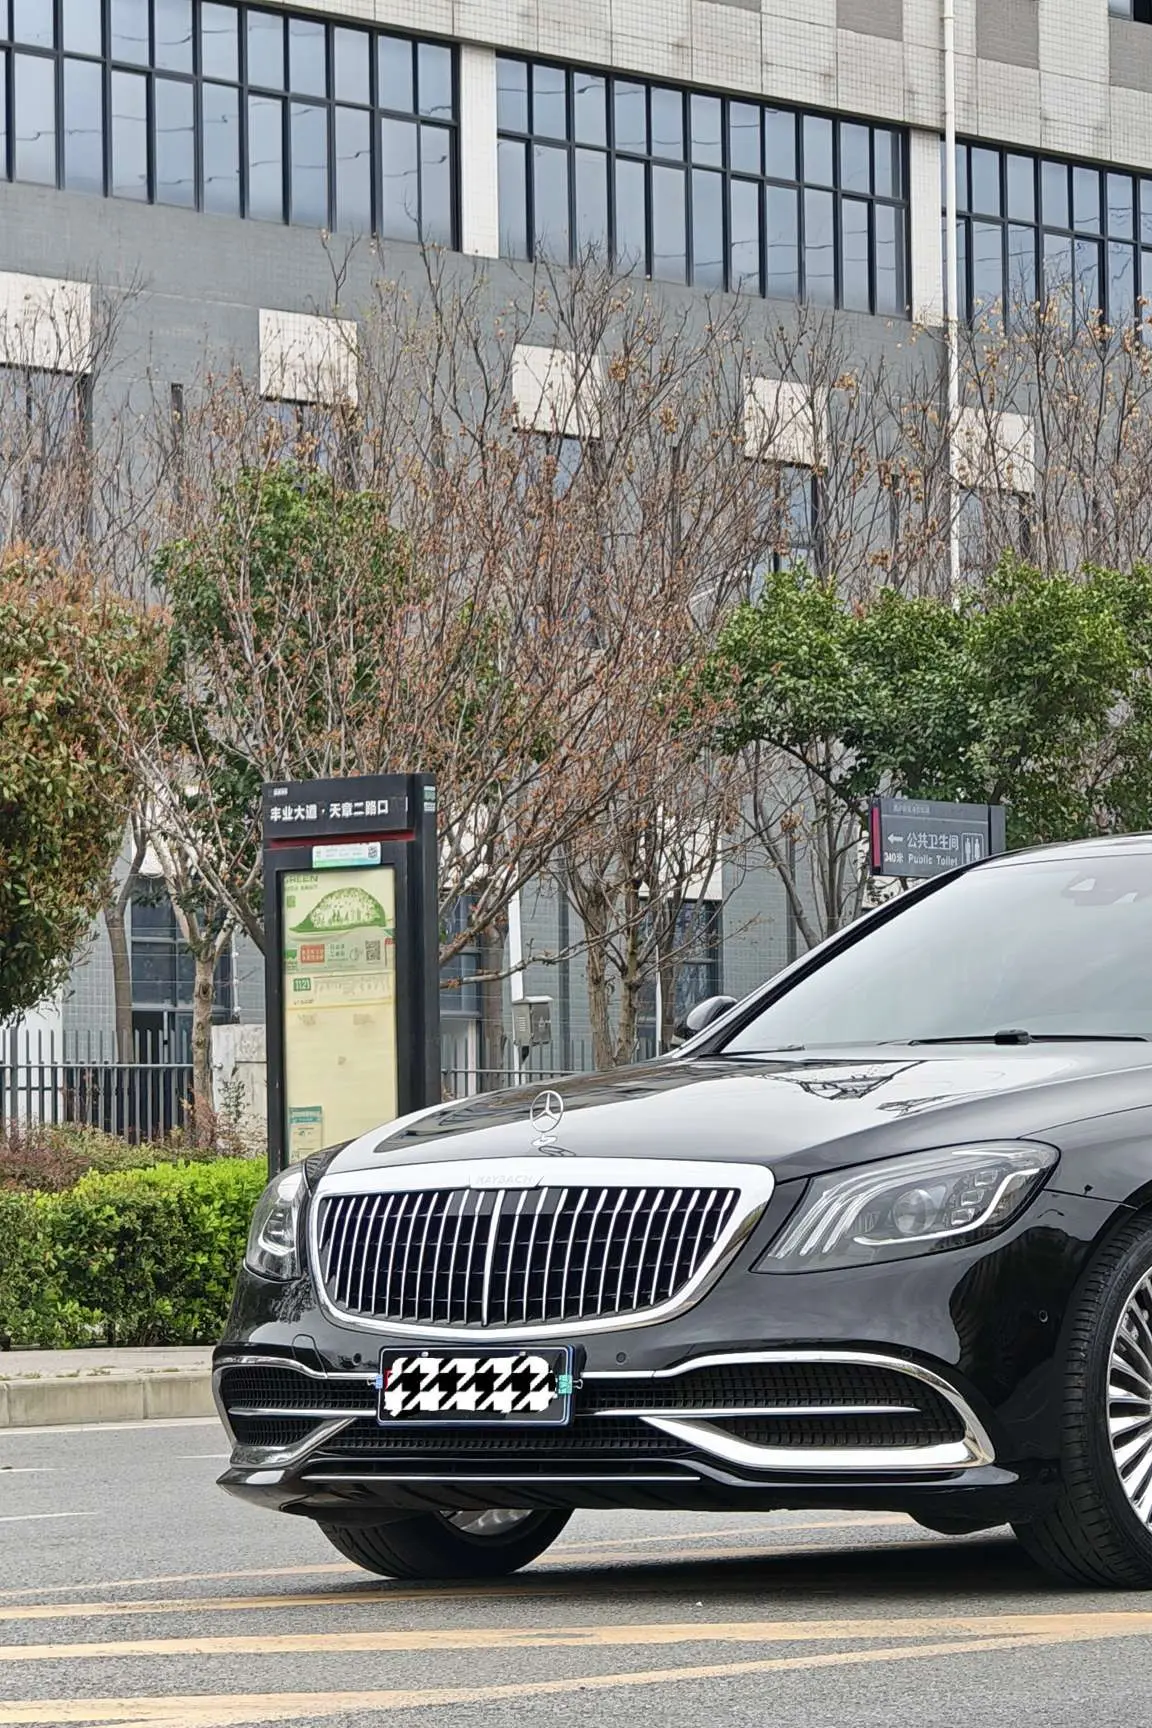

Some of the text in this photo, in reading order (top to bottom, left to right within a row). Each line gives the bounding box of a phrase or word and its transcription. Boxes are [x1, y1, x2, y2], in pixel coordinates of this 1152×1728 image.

[906, 832, 959, 850] 公共卫生间
[908, 853, 958, 866] Public Toilet
